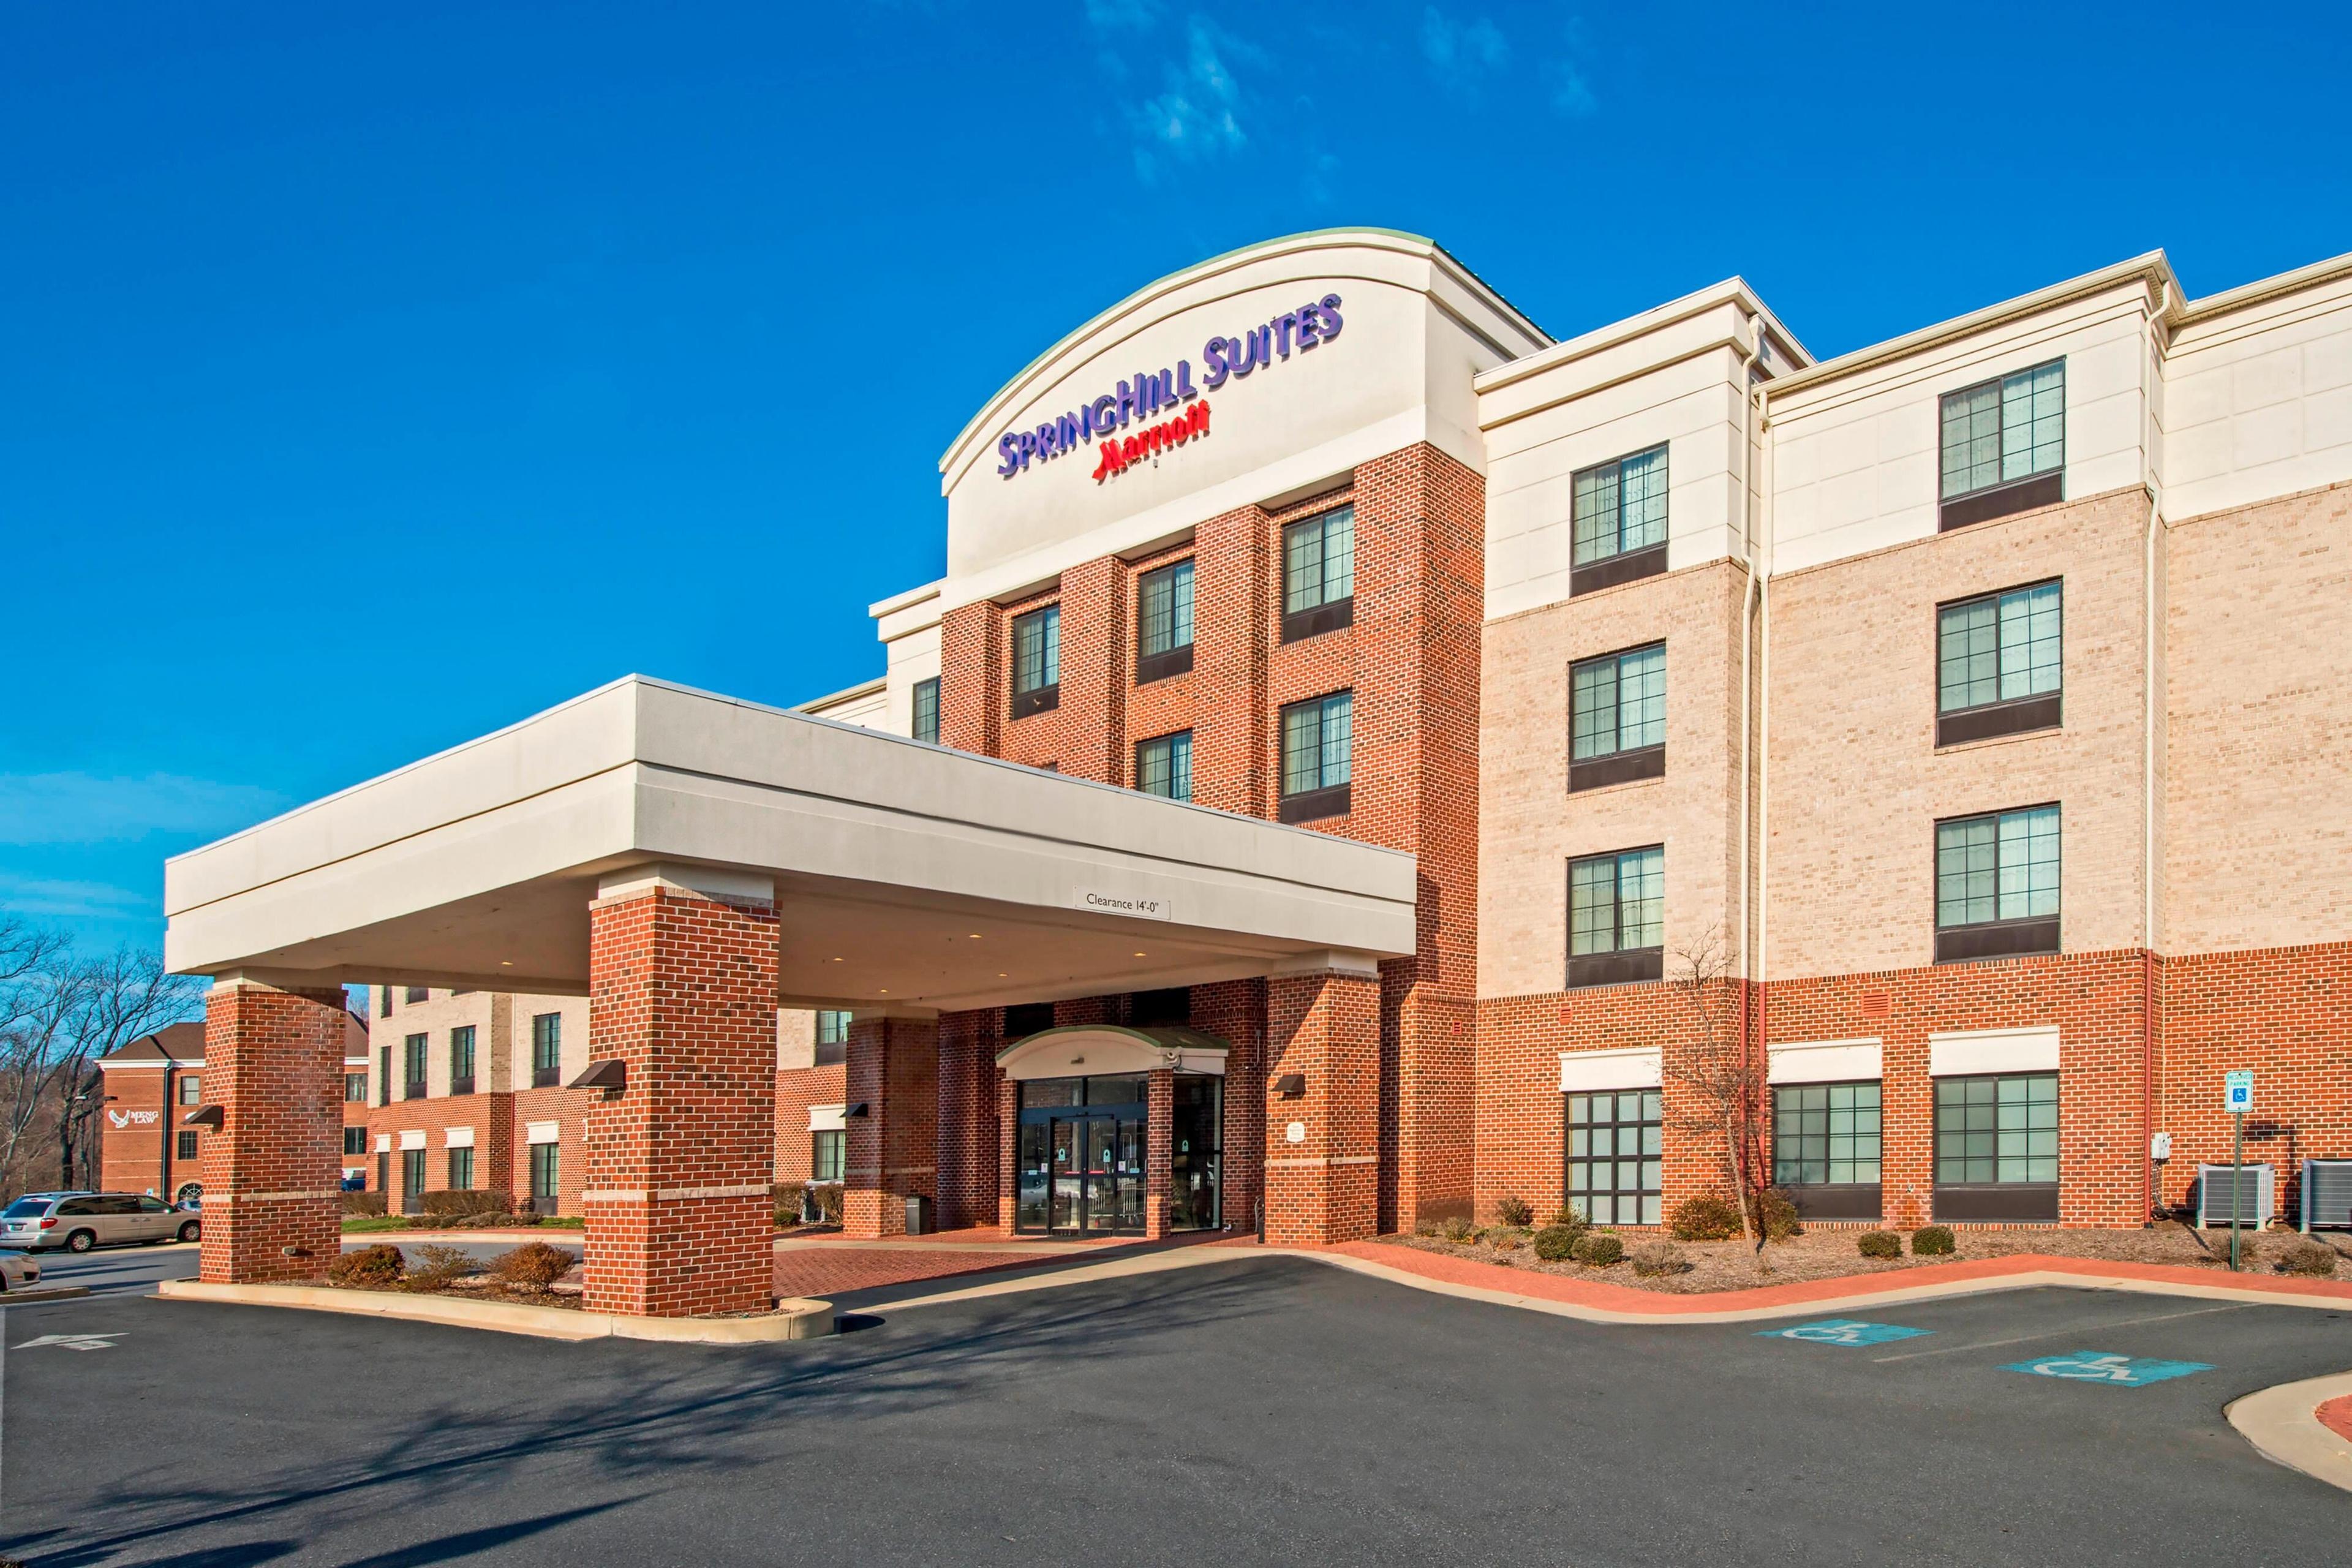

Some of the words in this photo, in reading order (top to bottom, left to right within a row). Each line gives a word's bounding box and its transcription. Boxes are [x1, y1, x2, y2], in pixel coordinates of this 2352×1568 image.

[997, 359, 1197, 478] SPRINGHILL
[1202, 293, 1344, 390] SUITES
[1091, 399, 1212, 483] Marriott
[1087, 893, 1133, 910] Clearance
